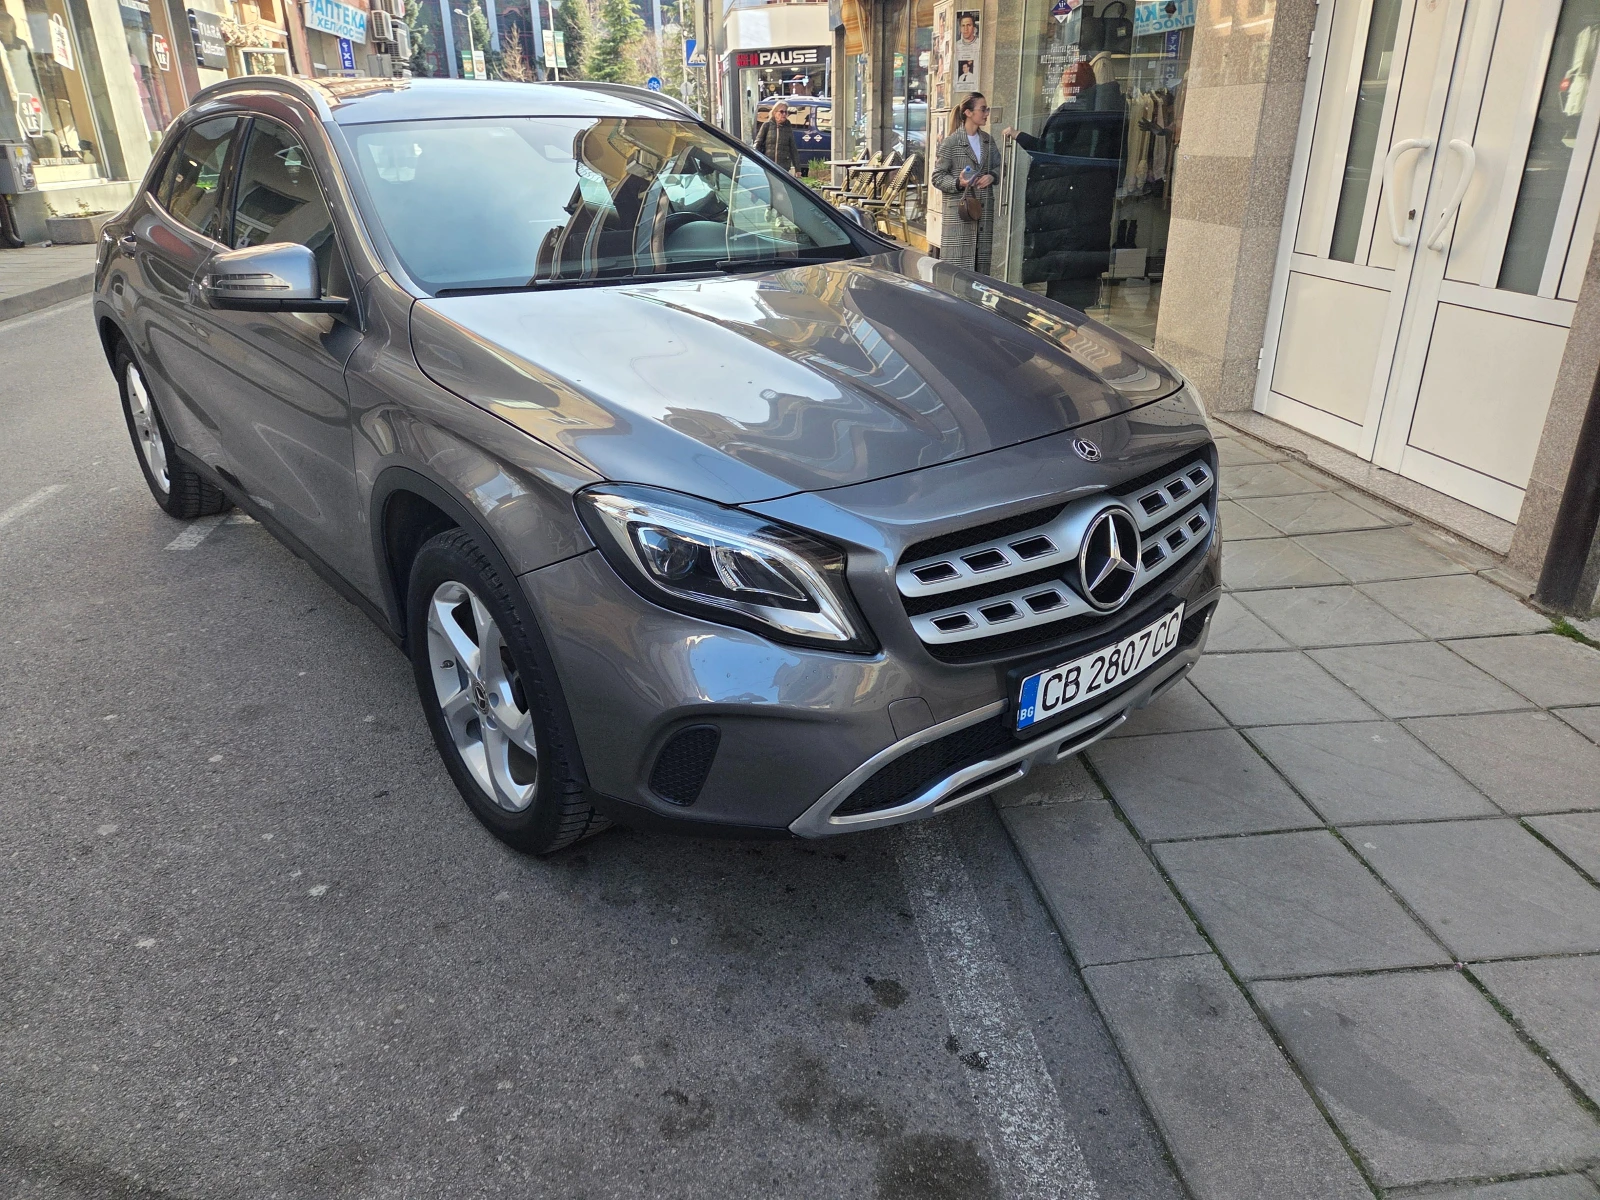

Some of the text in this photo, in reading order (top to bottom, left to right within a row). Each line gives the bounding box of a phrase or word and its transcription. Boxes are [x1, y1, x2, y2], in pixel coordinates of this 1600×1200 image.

[314, 0, 366, 31] АПТЕКА
[316, 16, 355, 38] ХЕЛИОС
[760, 49, 818, 65] PAUSE
[1041, 612, 1179, 711] CB 2807 CC
[1020, 707, 1034, 721] BG
